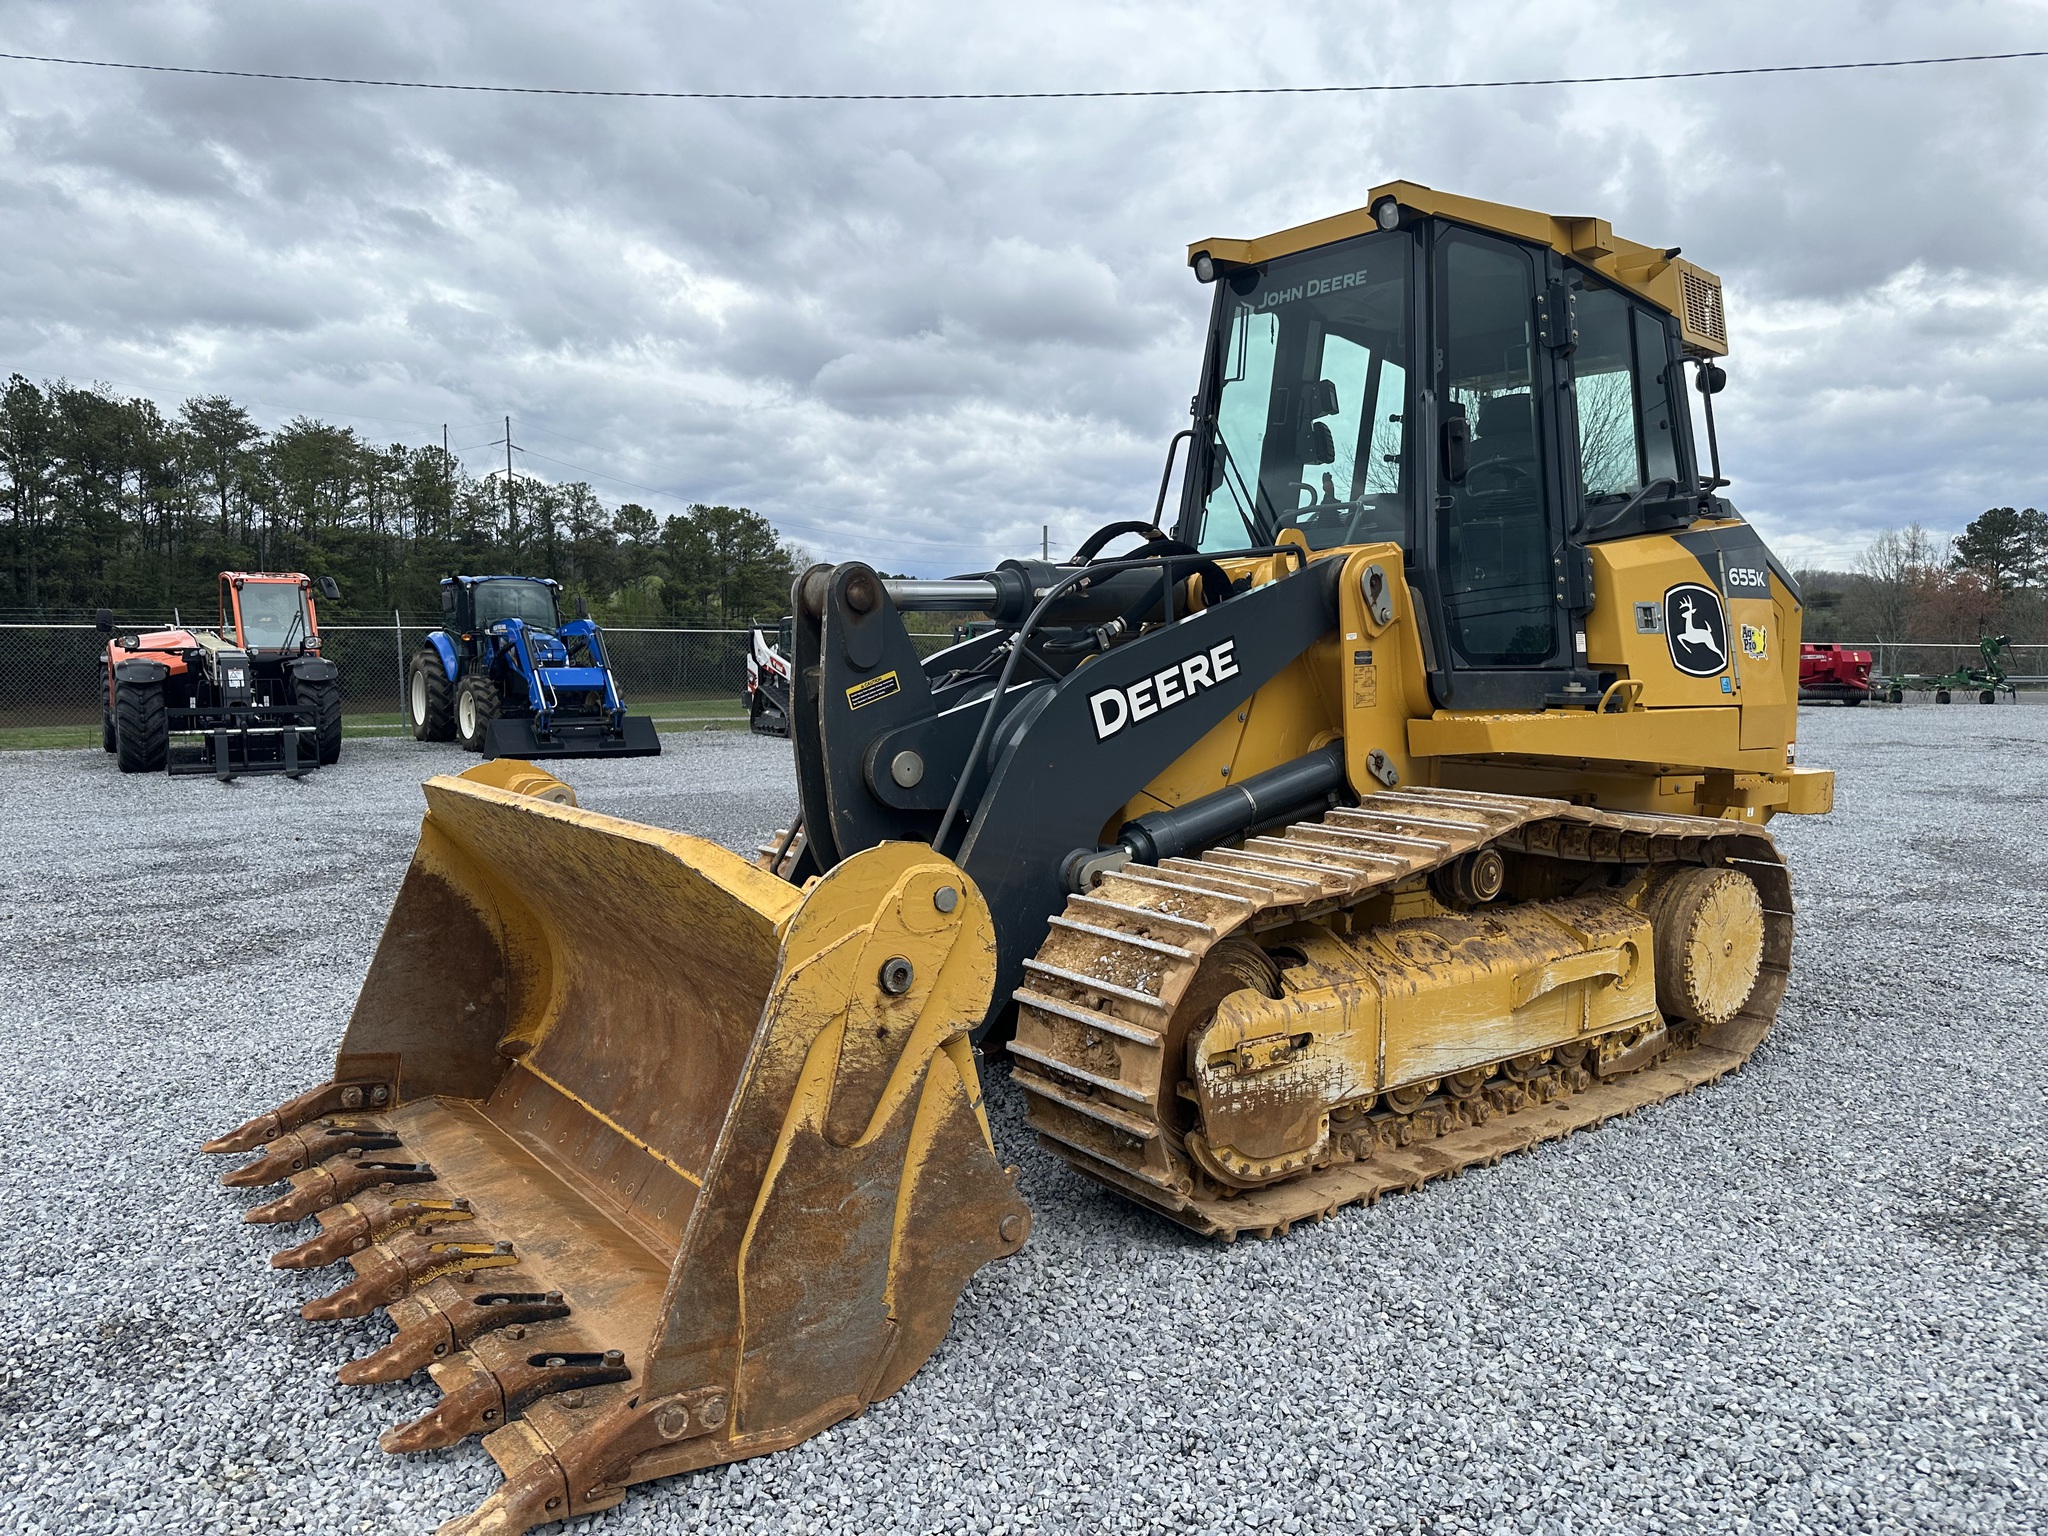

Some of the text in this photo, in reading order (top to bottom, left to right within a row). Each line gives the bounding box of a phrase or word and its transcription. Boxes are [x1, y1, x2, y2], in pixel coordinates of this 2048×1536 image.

[1258, 269, 1368, 309] JOHN DEERE
[1728, 567, 1766, 587] 655K
[1089, 639, 1240, 740] DEERE
